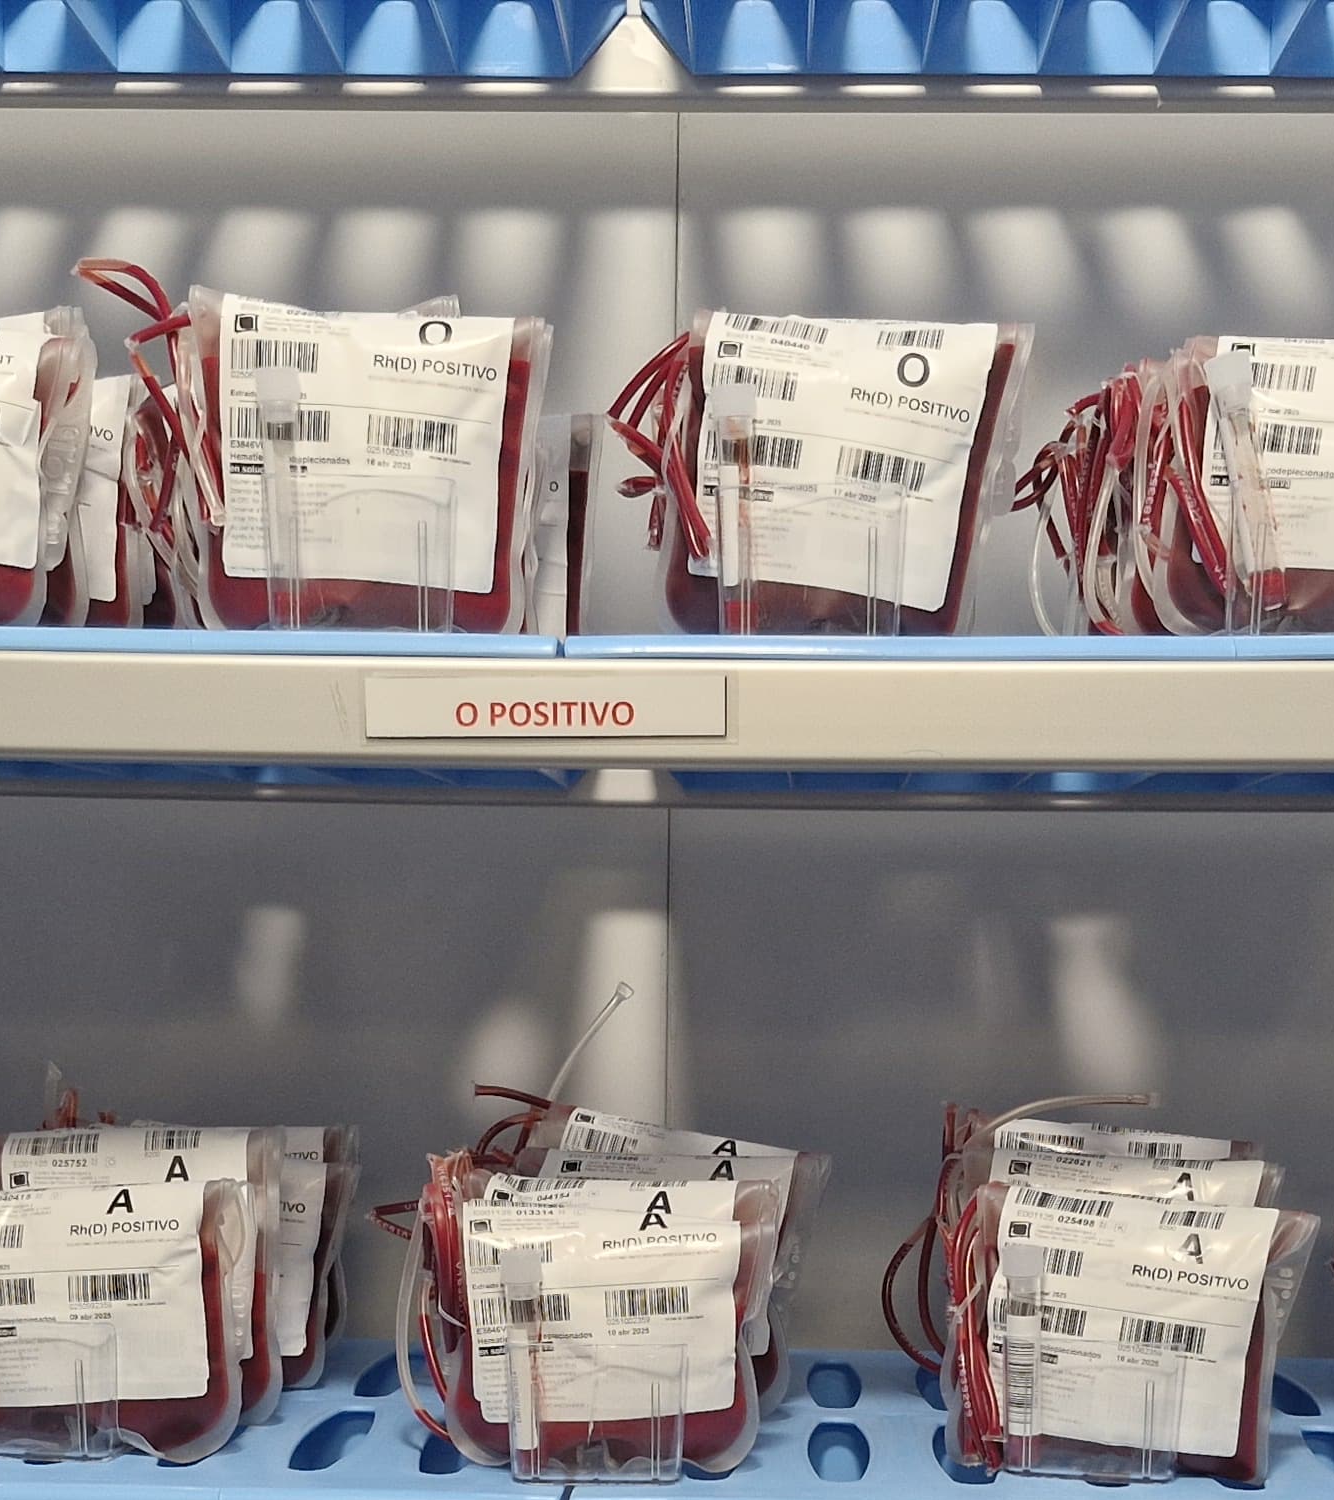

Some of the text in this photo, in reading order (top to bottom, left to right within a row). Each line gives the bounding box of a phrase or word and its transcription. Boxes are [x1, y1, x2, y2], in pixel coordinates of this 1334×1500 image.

[373, 354, 497, 381] Rh(D) POSITIVO
[896, 353, 930, 388] O
[850, 387, 970, 423] Rh(D) POSITIVO
[455, 701, 635, 727] O POSITIVO
[51, 1158, 88, 1168] 025752
[164, 1155, 189, 1182] A
[106, 1188, 134, 1214] A
[647, 1190, 672, 1214] A
[69, 1218, 179, 1237] Rh(D) POSITIVO
[1131, 1264, 1249, 1290] Rh(D) POSITIVO
